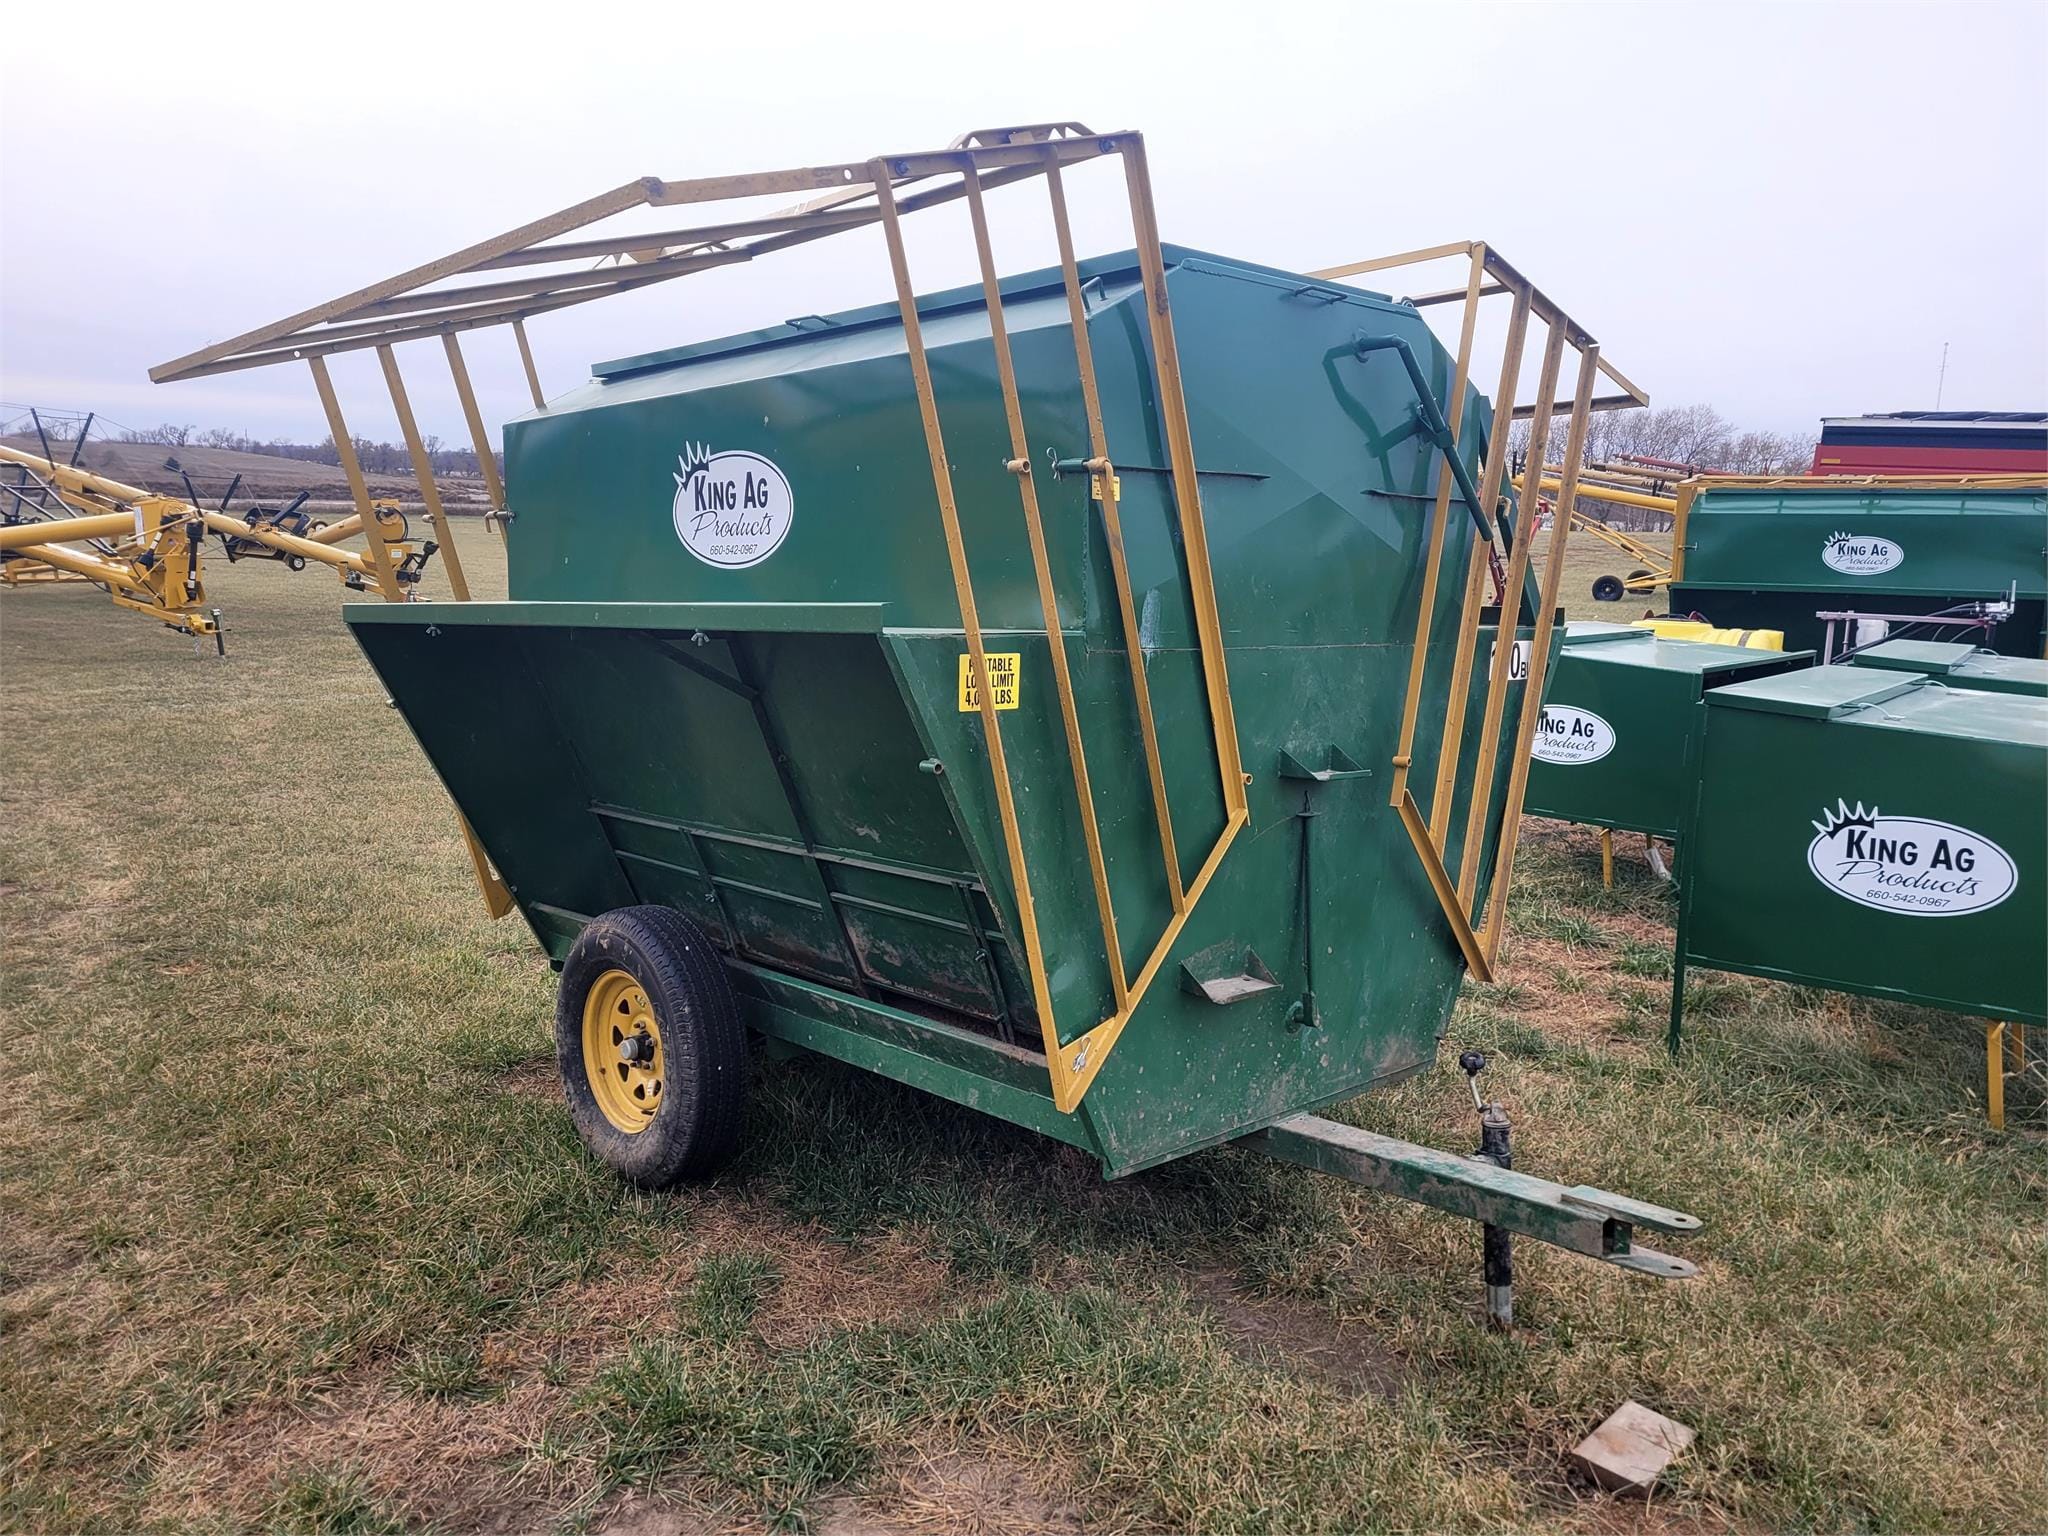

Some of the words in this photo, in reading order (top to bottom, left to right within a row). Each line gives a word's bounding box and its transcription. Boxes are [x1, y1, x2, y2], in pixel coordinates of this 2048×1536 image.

[690, 510, 774, 541] Products
[709, 544, 758, 556] 660-542-0967
[968, 657, 1013, 673] PTABLE
[992, 673, 1015, 688] LIMIT
[995, 689, 1015, 705] LBS.
[1536, 718, 1566, 735] ING
[1836, 860, 1984, 897] Products
[1866, 889, 1951, 908] 660-542-0967
